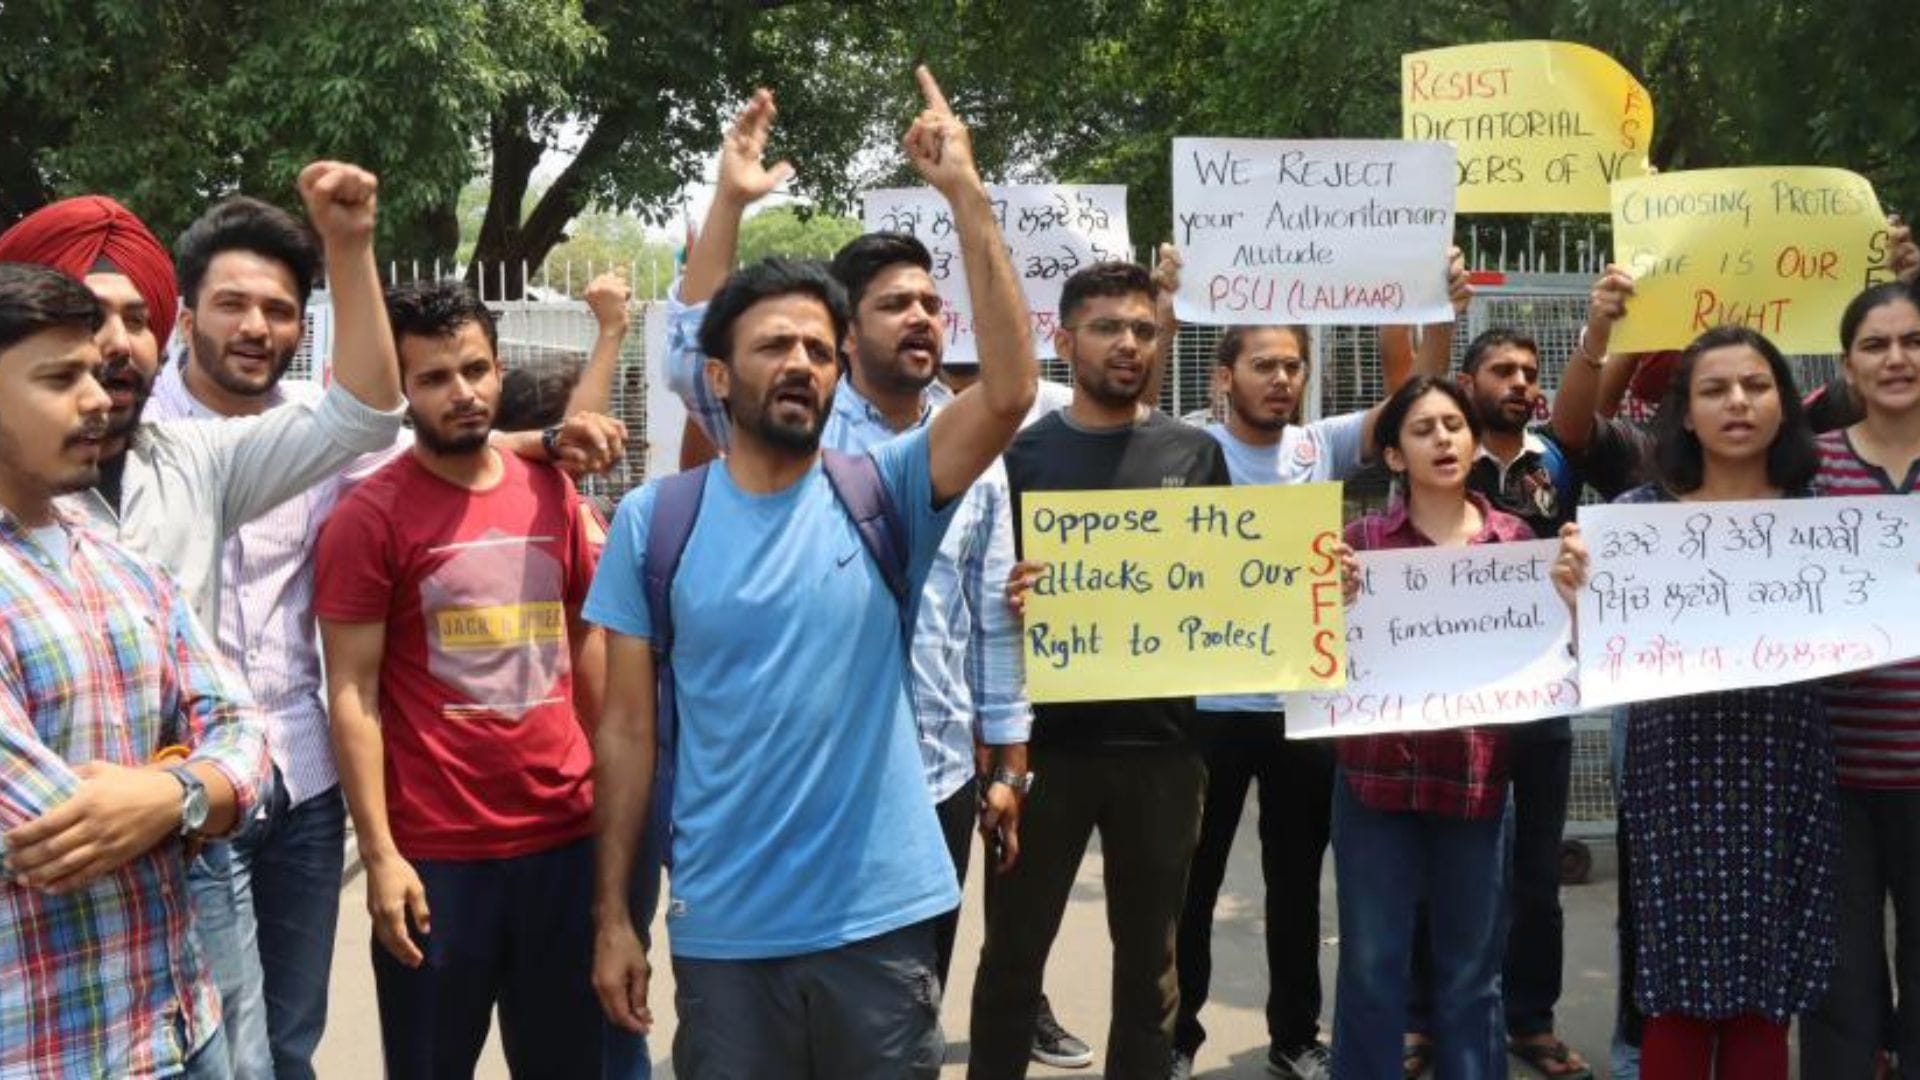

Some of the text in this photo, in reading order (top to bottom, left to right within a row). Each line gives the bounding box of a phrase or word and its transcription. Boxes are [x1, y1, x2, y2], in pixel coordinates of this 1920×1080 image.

[1411, 109, 1595, 142] DICTATORIAL
[1193, 150, 1395, 187] WE REJECT
[1545, 154, 1580, 184] OF
[1622, 179, 1868, 229] CHOOSING PROTES
[1180, 211, 1243, 245] your
[1233, 242, 1335, 267] Attitude
[1720, 252, 1756, 276] IS
[1776, 246, 1839, 281] OUR
[1209, 274, 1405, 318] PSU (LALKAAR)
[1032, 503, 1263, 544] Oppose the
[1033, 558, 1303, 596] attacks On Our
[1403, 564, 1428, 592] to
[1451, 555, 1549, 587] Protest
[1309, 531, 1341, 679] SFS
[1028, 615, 1277, 668] Right to Protest
